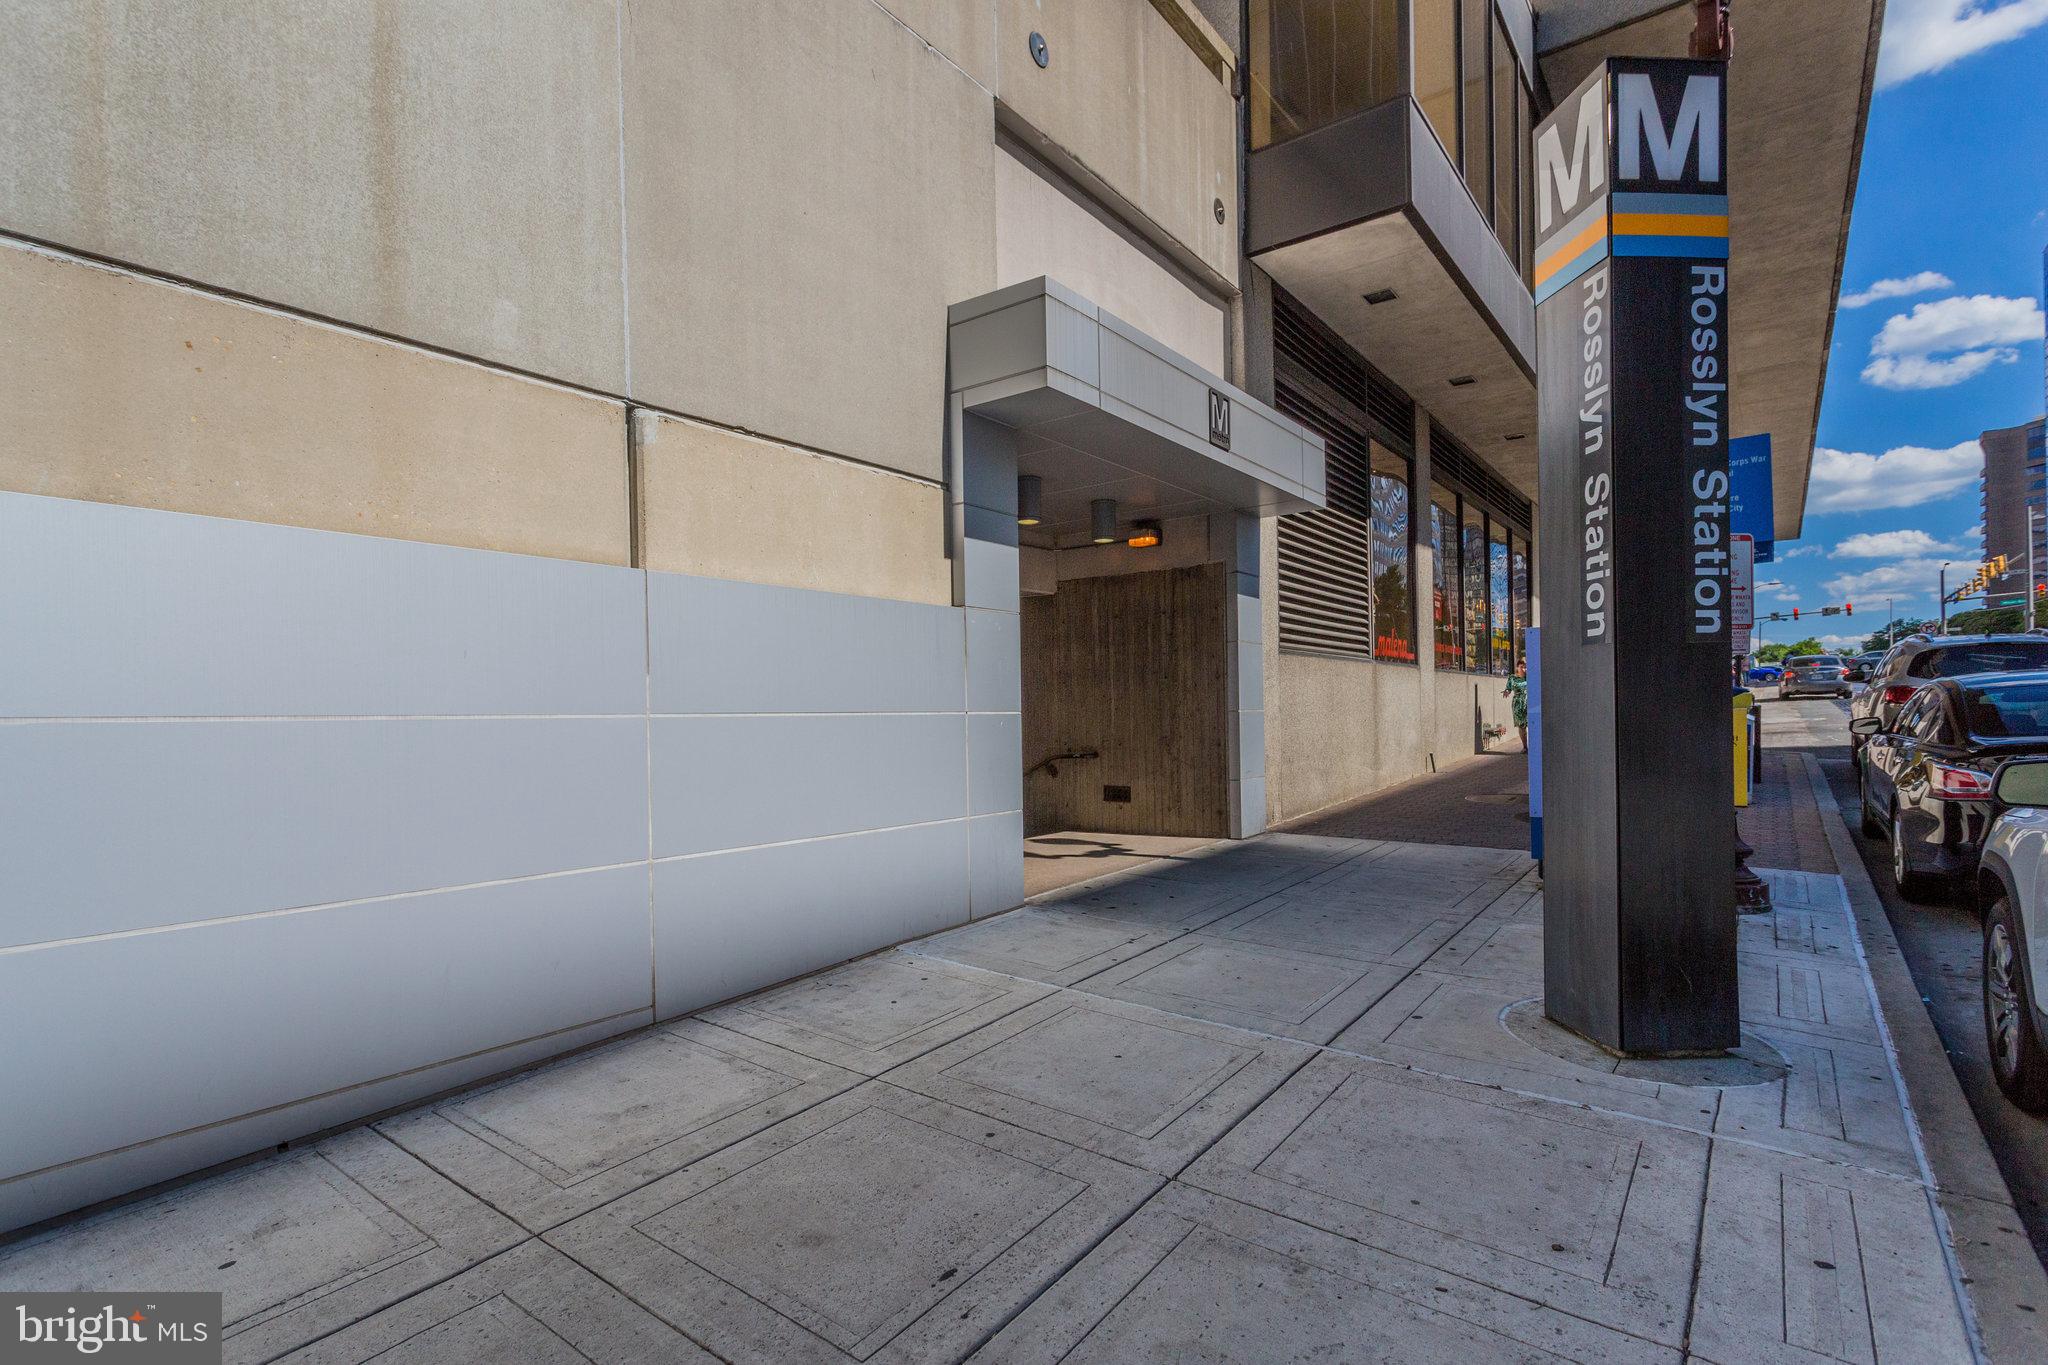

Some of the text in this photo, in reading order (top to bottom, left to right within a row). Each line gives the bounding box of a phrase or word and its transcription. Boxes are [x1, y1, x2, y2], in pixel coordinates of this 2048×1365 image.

[1538, 78, 1604, 233] M
[1618, 73, 1719, 182] M
[1211, 393, 1228, 435] M
[1580, 267, 1610, 637] Rosslyn Station
[1685, 266, 1728, 633] Rosslyn Station
[1751, 455, 1766, 463] War
